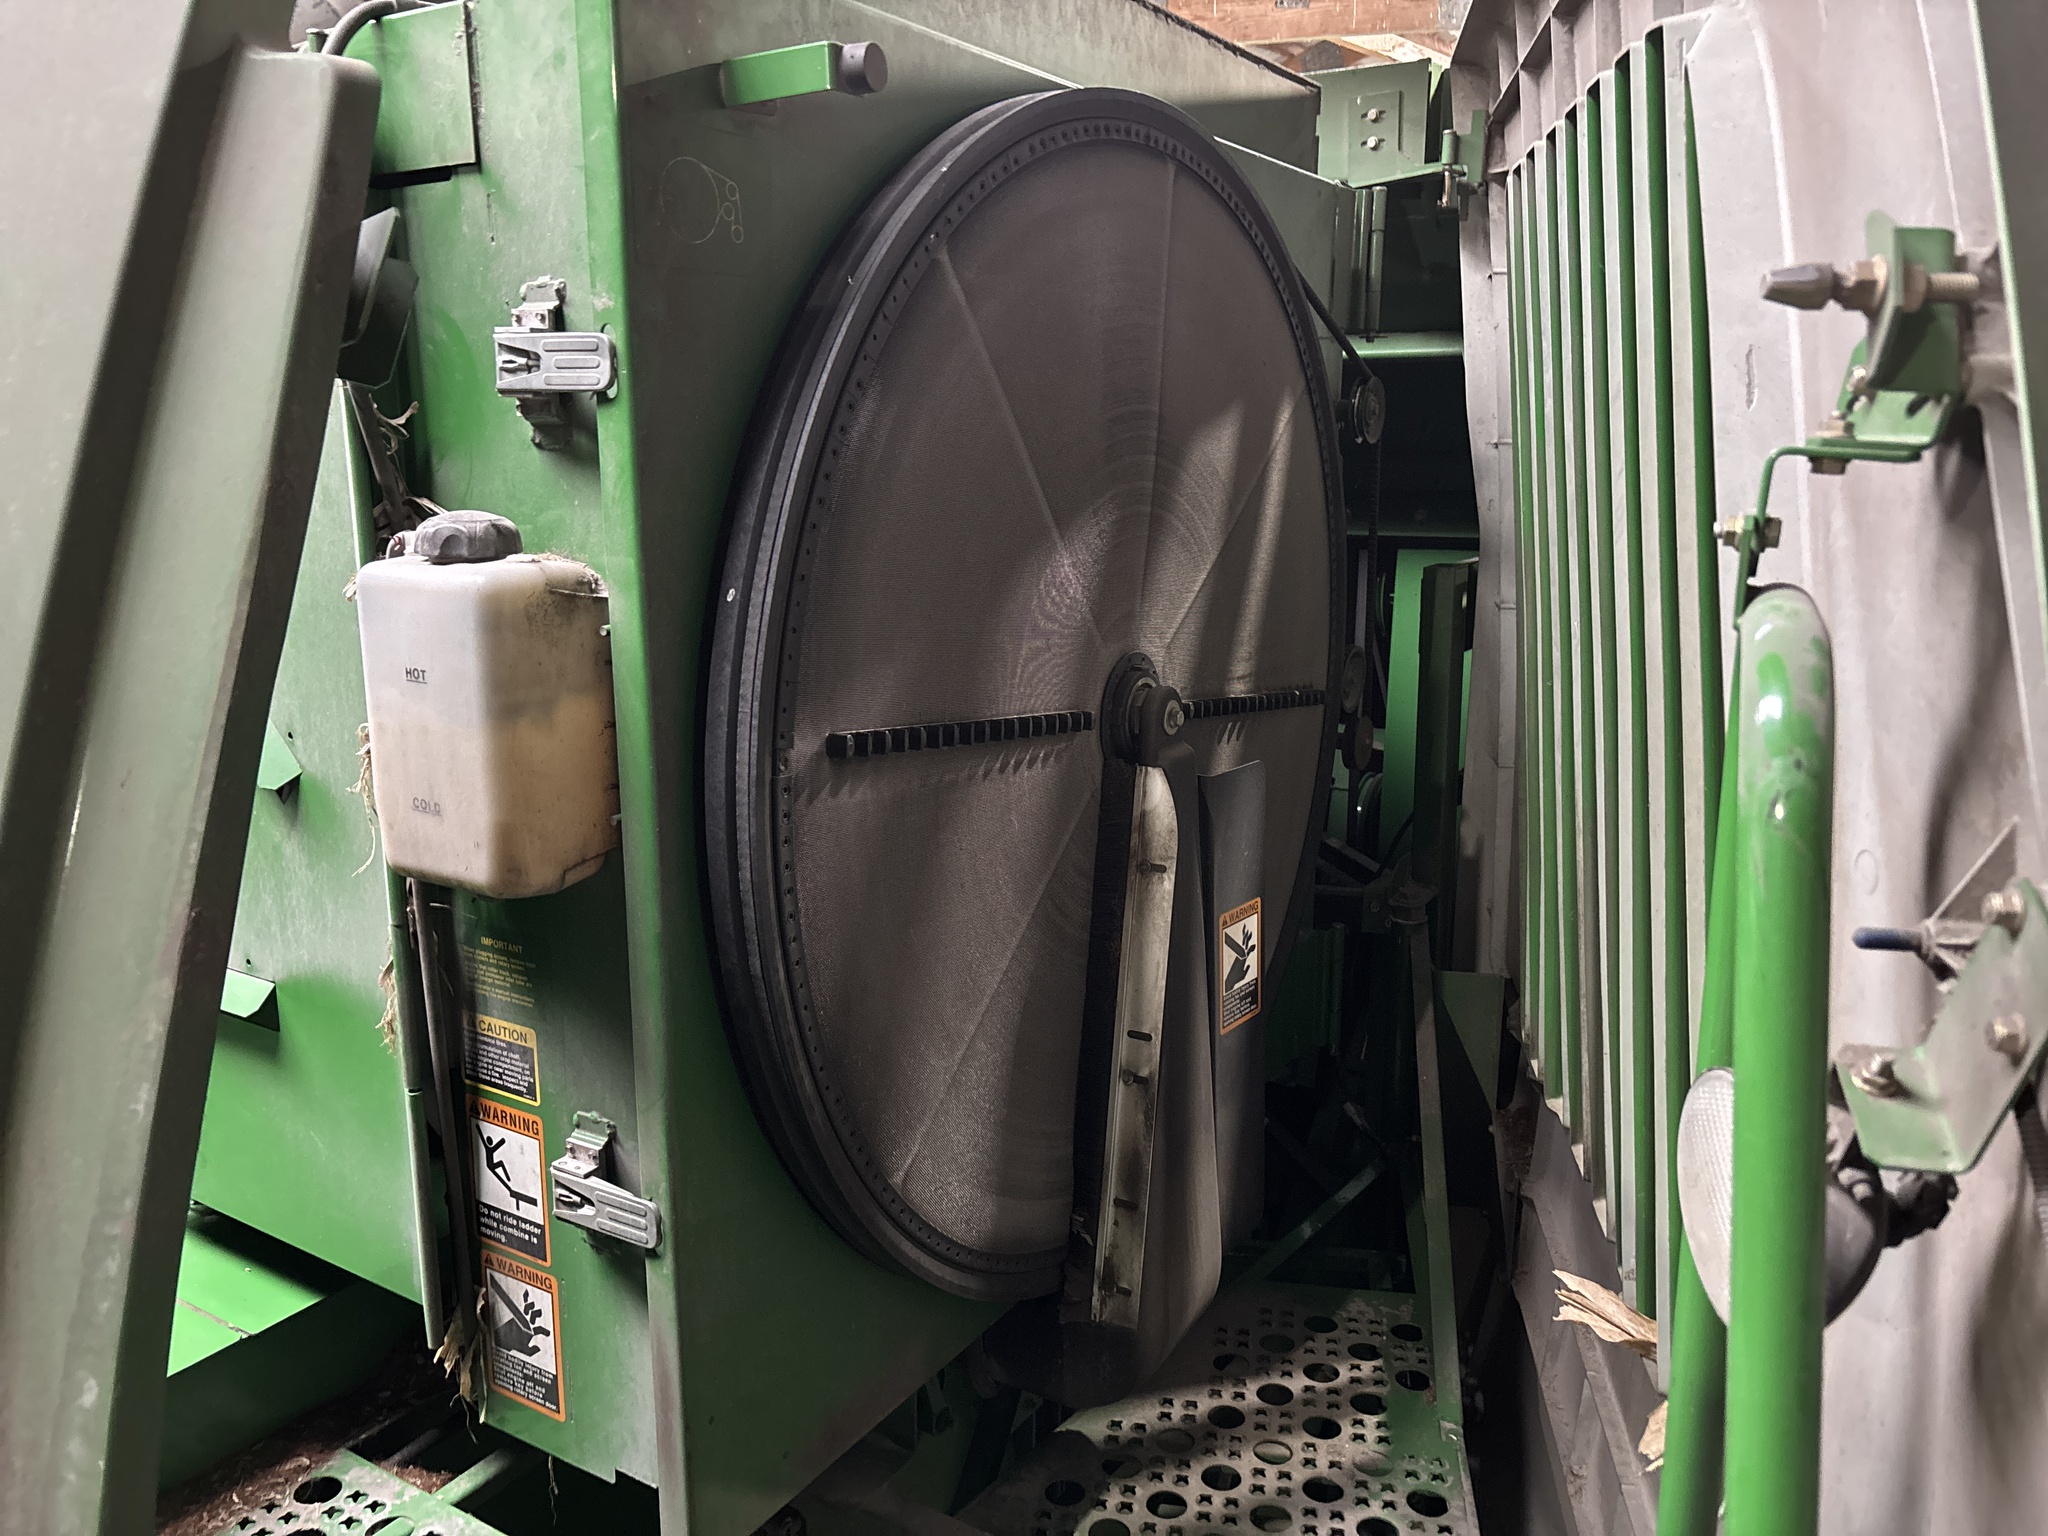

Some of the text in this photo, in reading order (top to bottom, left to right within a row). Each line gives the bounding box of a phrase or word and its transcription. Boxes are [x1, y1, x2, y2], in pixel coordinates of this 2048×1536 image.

[405, 667, 426, 681] HOT
[1229, 901, 1259, 922] WARNING
[481, 936, 522, 954] IMPORTANT
[478, 1020, 528, 1044] CAUTION
[480, 1103, 539, 1136] WARNING
[479, 1204, 541, 1236] Do not ride ladder
[480, 1216, 538, 1244] while combine is
[480, 1226, 508, 1243] moving.
[497, 1257, 553, 1290] WARNING
